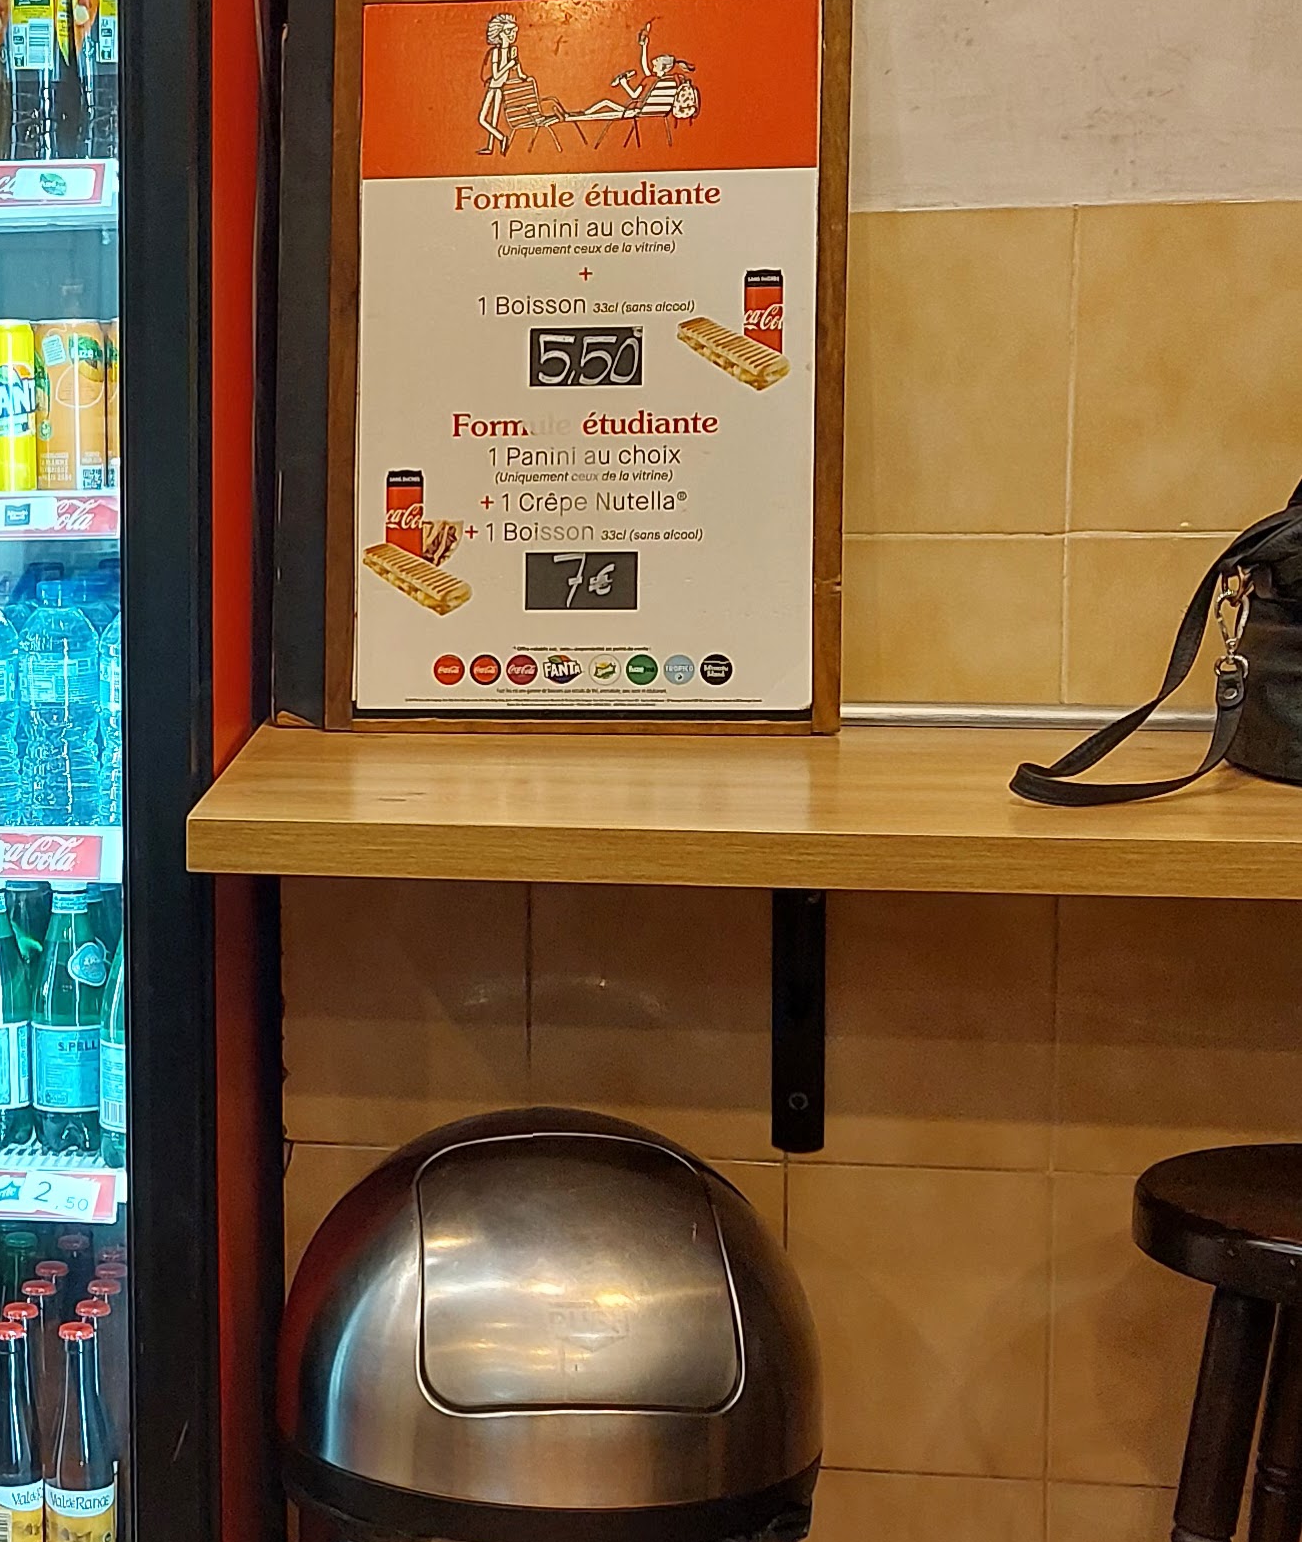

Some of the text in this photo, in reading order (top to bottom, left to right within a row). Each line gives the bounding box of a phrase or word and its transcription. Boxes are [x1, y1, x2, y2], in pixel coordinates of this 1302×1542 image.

[454, 180, 722, 211] Formule étudiante
[490, 215, 685, 240] 1 Panini au choix
[497, 239, 677, 259] (Uniquement ceux de la vitrine)
[477, 296, 487, 316] 1
[496, 294, 587, 316] Boisson
[592, 300, 619, 314] 33cl
[621, 300, 653, 315] (sans
[582, 409, 720, 437] étudiante
[488, 444, 682, 468] 1 Panini au choix
[494, 469, 674, 485] (Uniquement ceux de la vitrine)
[501, 492, 511, 513] 1
[518, 491, 589, 517] Crêpe
[484, 522, 495, 543] 1
[503, 521, 595, 543] Boisson
[600, 528, 628, 542] 33cl
[628, 528, 662, 543] (sans
[662, 527, 704, 542] alcool)
[543, 660, 582, 678] FANTA
